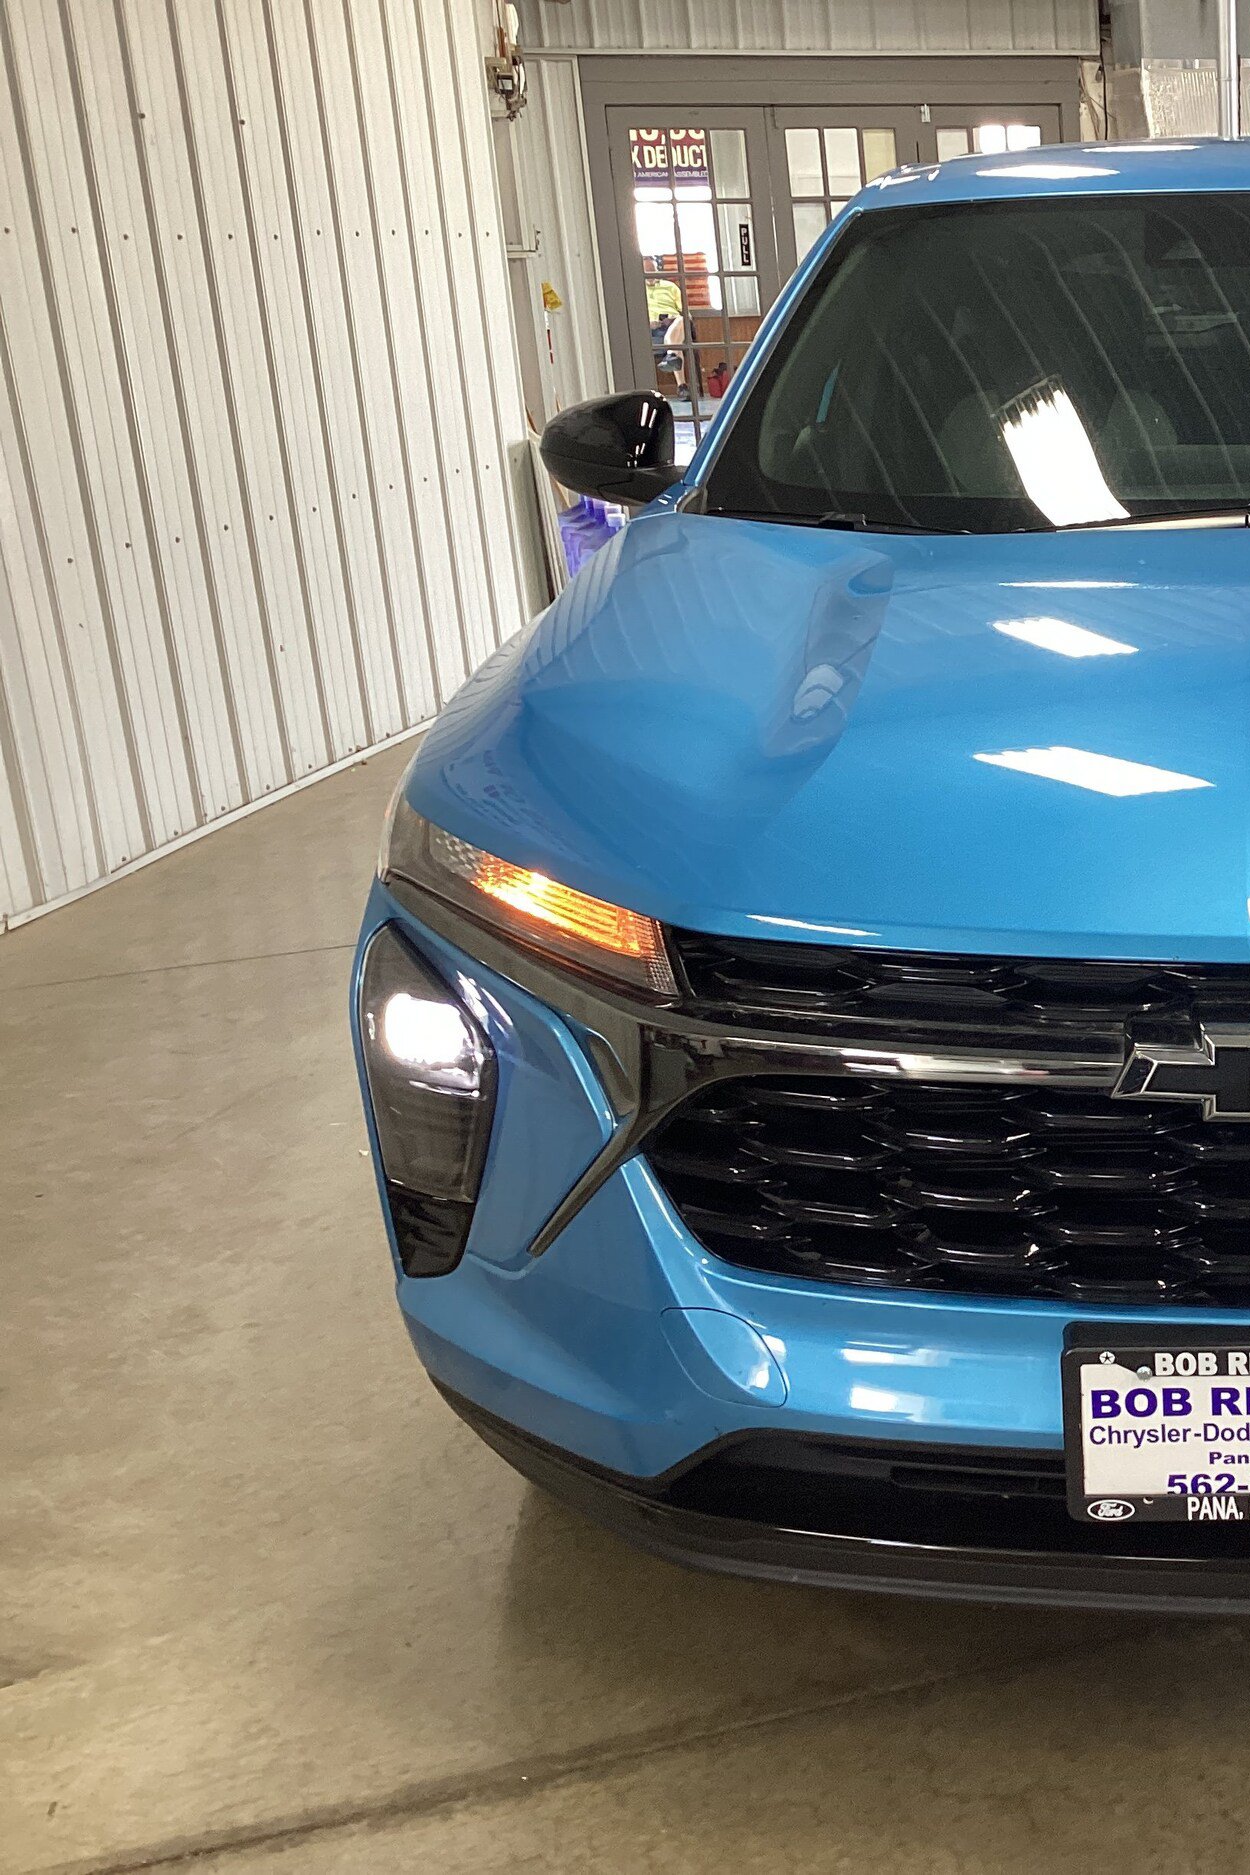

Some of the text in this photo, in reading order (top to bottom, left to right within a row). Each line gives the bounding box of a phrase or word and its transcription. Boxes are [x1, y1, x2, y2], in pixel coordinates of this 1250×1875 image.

[741, 227, 749, 263] PULL
[1154, 1352, 1218, 1376] BOB
[1091, 1388, 1193, 1419] BOB
[1098, 1502, 1123, 1517] Ford
[1187, 1496, 1244, 1521] PANA,
